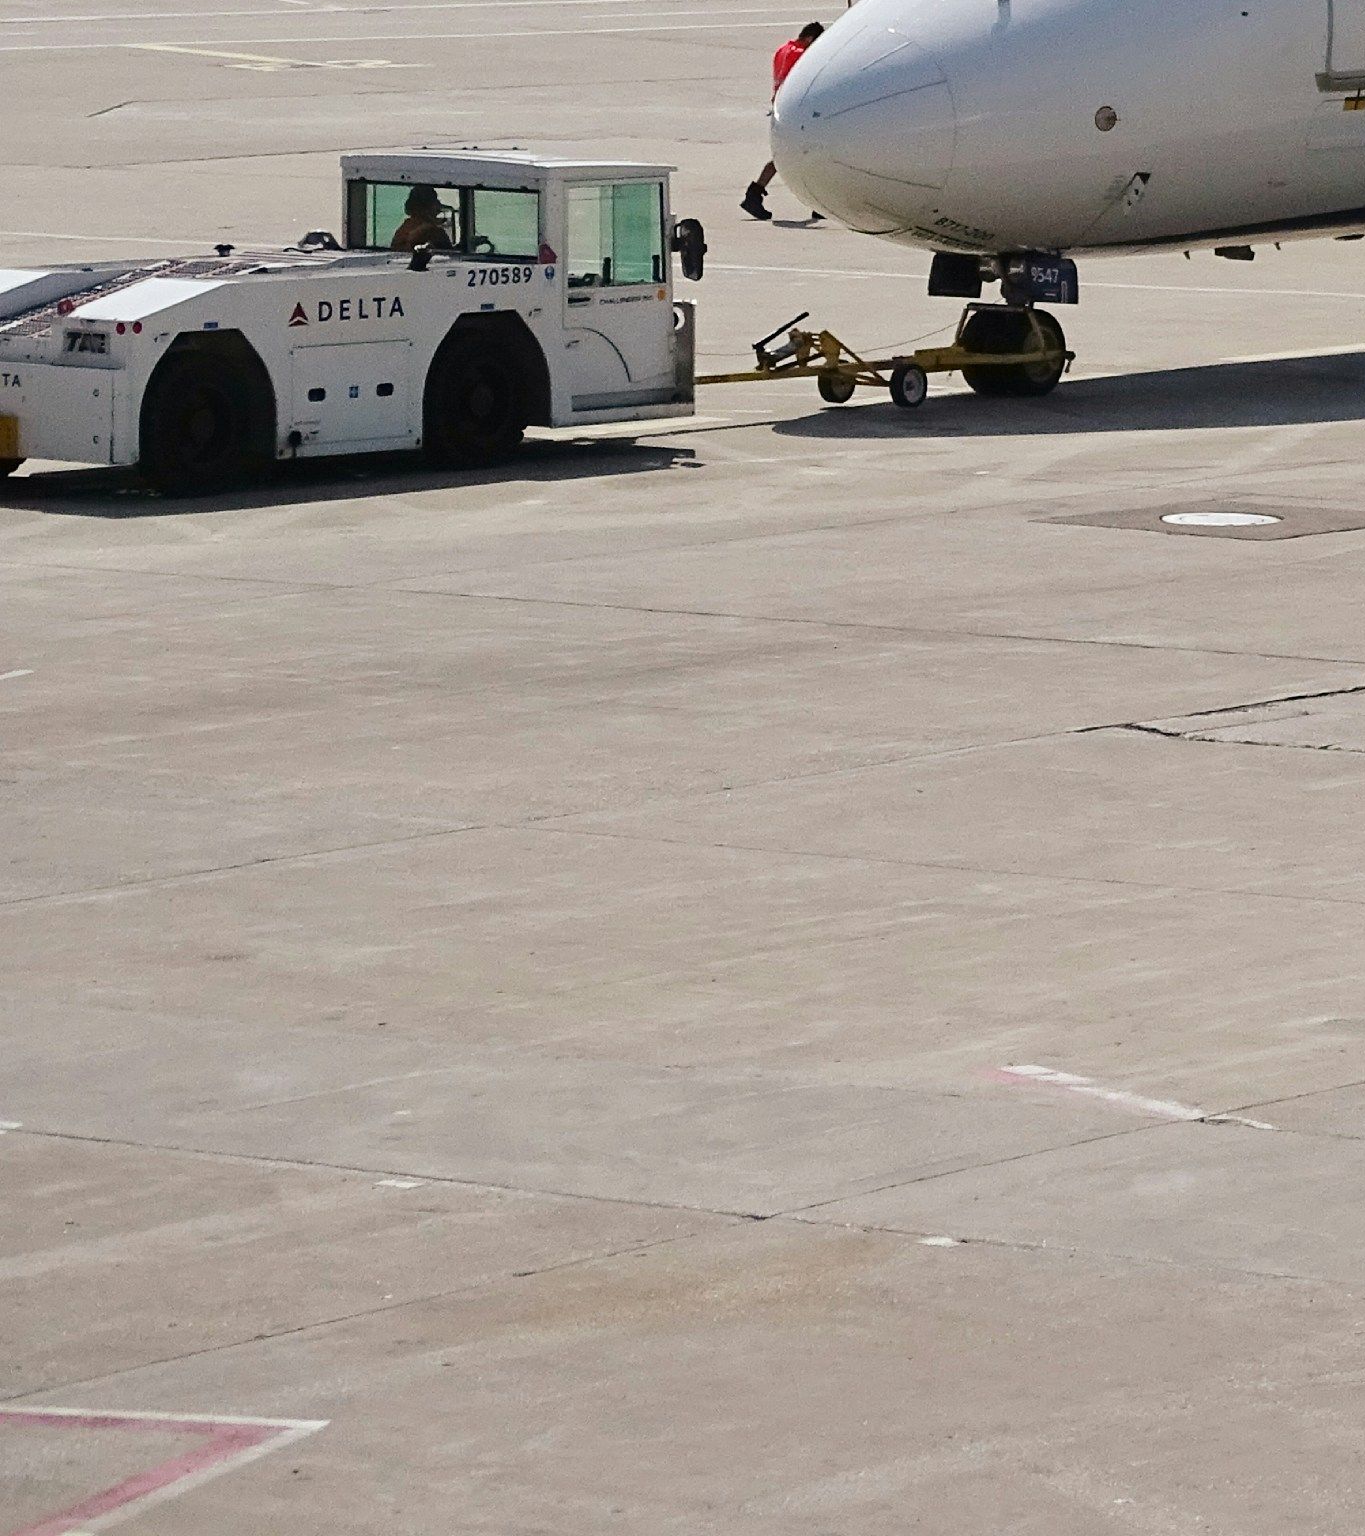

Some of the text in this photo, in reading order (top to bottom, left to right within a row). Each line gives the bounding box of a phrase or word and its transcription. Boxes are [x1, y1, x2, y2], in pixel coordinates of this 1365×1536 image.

[467, 266, 533, 288] 270589
[1030, 267, 1060, 283] 9547
[318, 296, 405, 322] DELTA
